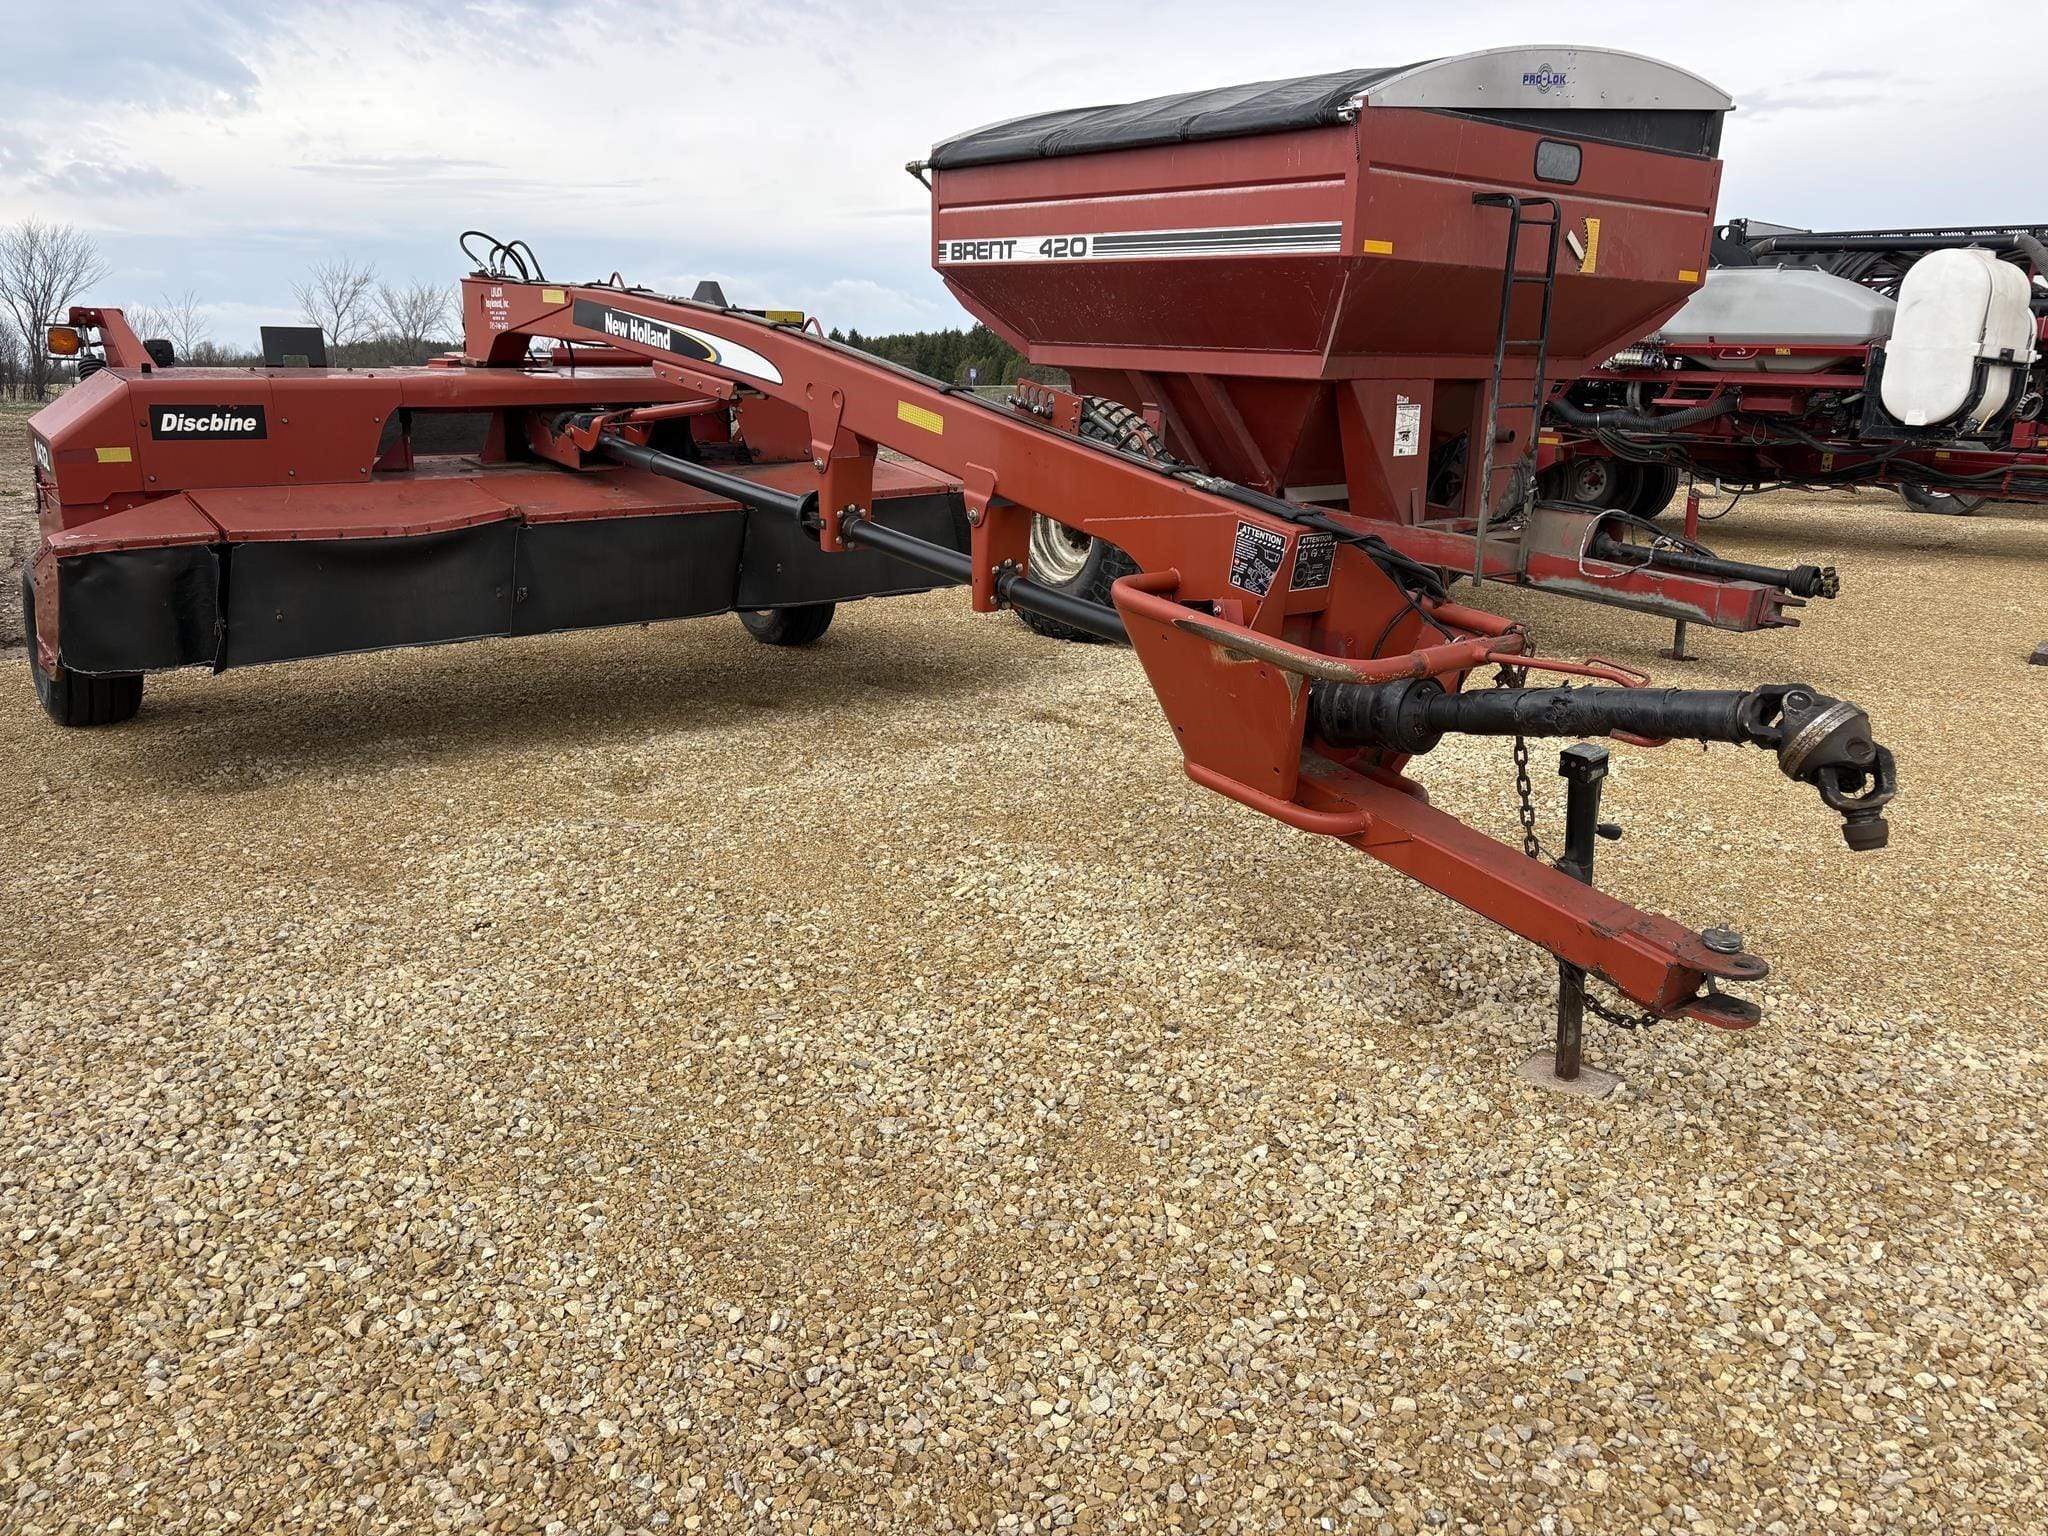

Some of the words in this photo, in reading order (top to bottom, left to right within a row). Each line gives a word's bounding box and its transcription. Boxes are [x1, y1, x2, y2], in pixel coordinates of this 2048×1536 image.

[951, 240, 1017, 260] BRENT
[1039, 236, 1087, 258] 420
[604, 311, 628, 338] New
[630, 318, 671, 351] Holland
[160, 413, 257, 432] Discbine
[1240, 525, 1283, 546] ATTENTION
[1302, 534, 1333, 544] ATTENTION
